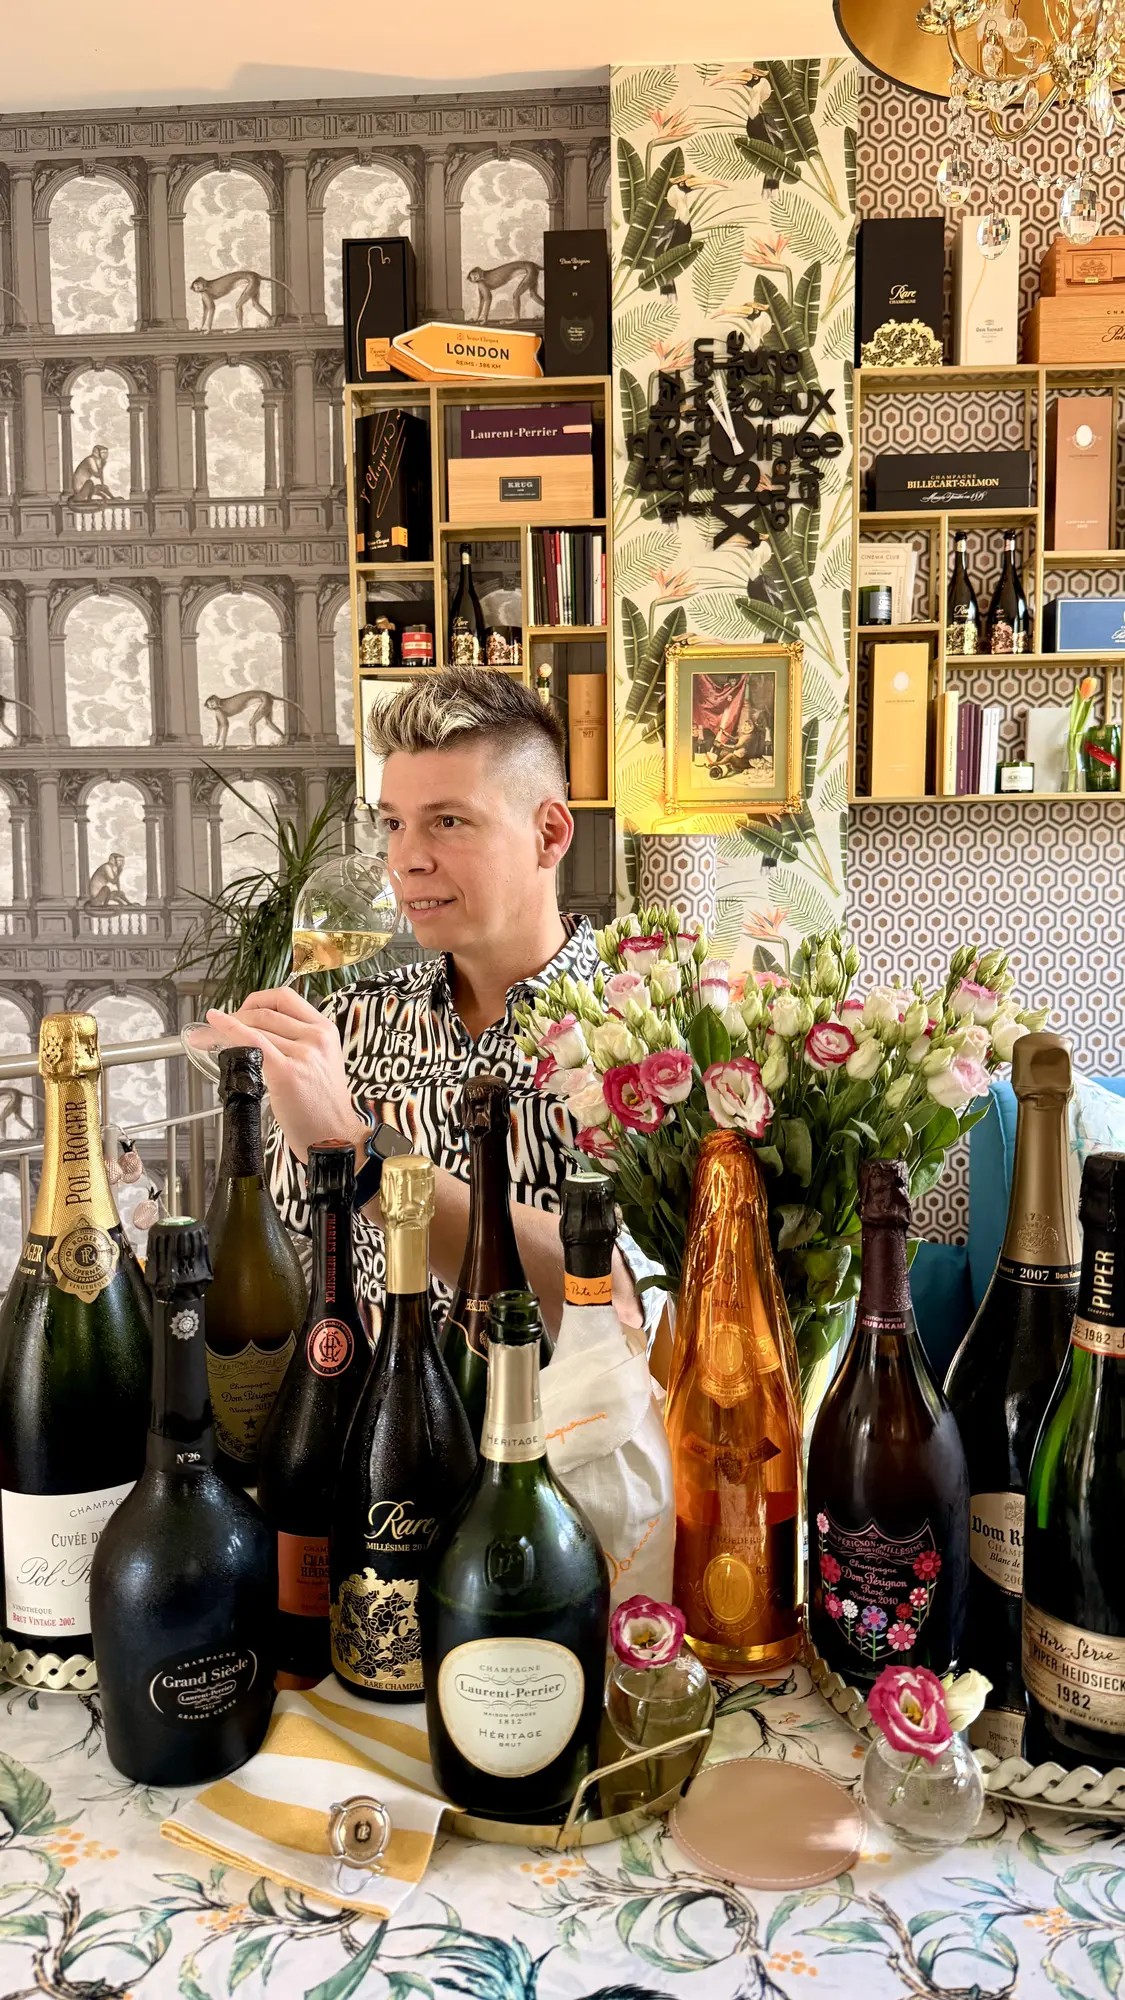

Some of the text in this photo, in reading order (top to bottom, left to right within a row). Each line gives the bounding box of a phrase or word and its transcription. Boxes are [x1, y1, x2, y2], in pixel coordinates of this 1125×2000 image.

[889, 284, 917, 300] Rare
[446, 342, 510, 361] LONDON
[742, 380, 837, 418] deux
[470, 426, 558, 440] Laurent-Perrier
[507, 481, 533, 489] KRUG
[907, 478, 999, 489] BILLECART-SALMON
[63, 1099, 92, 1207] POL ROGER
[72, 1235, 97, 1246] ROGER
[79, 1274, 100, 1282] FRANCE
[325, 1255, 337, 1304] HEIDSIECK
[1020, 1267, 1049, 1281] 2007
[1091, 1250, 1115, 1309] PIPER
[861, 1319, 906, 1329] MURAKAMI
[1084, 1327, 1111, 1346] 1982
[221, 1391, 243, 1403] Dom
[69, 1497, 123, 1518] CHAMPAG
[363, 1500, 436, 1540] Rare
[971, 1514, 1005, 1543] Dom
[849, 1558, 898, 1575] Champagne
[990, 1552, 1020, 1569] Blanc de
[16, 1556, 68, 1587] Pol
[841, 1565, 908, 1591] Dom Pérignon
[849, 1590, 899, 1605] Vintage 2010
[860, 1583, 885, 1597] Rosé
[177, 1651, 237, 1671] CHAMPAGNE
[478, 1664, 542, 1674] CHAMPAGNE
[1032, 1643, 1125, 1692] PIPER HEIDSIECK
[162, 1658, 249, 1689] Grand Siècle
[181, 1684, 234, 1702] Laurent-Perrier
[363, 1679, 425, 1692] RARE CHAMPAG
[460, 1680, 562, 1699] Laurent-Perrier
[1056, 1682, 1092, 1711] 1982
[478, 1727, 543, 1741] HÉRITAGE
